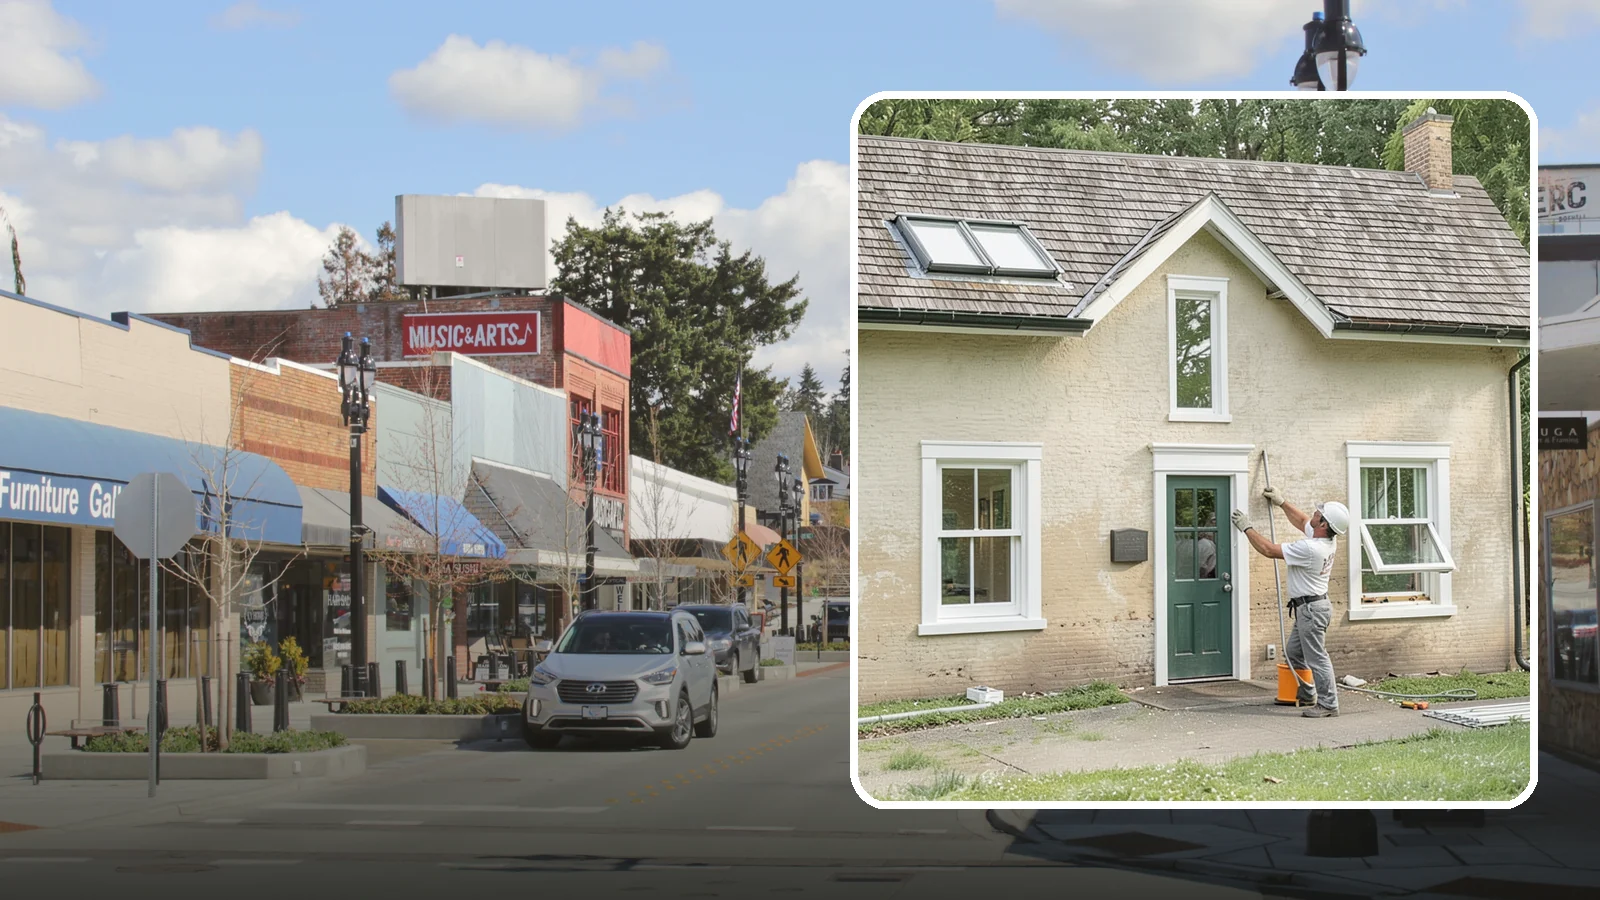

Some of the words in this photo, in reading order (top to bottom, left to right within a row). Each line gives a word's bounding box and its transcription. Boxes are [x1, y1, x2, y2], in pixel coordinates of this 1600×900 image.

[409, 323, 519, 349] MUSIC&ARTS
[1540, 427, 1577, 437] UGA
[0, 472, 79, 515] Furniture
[90, 483, 122, 519] Gal
